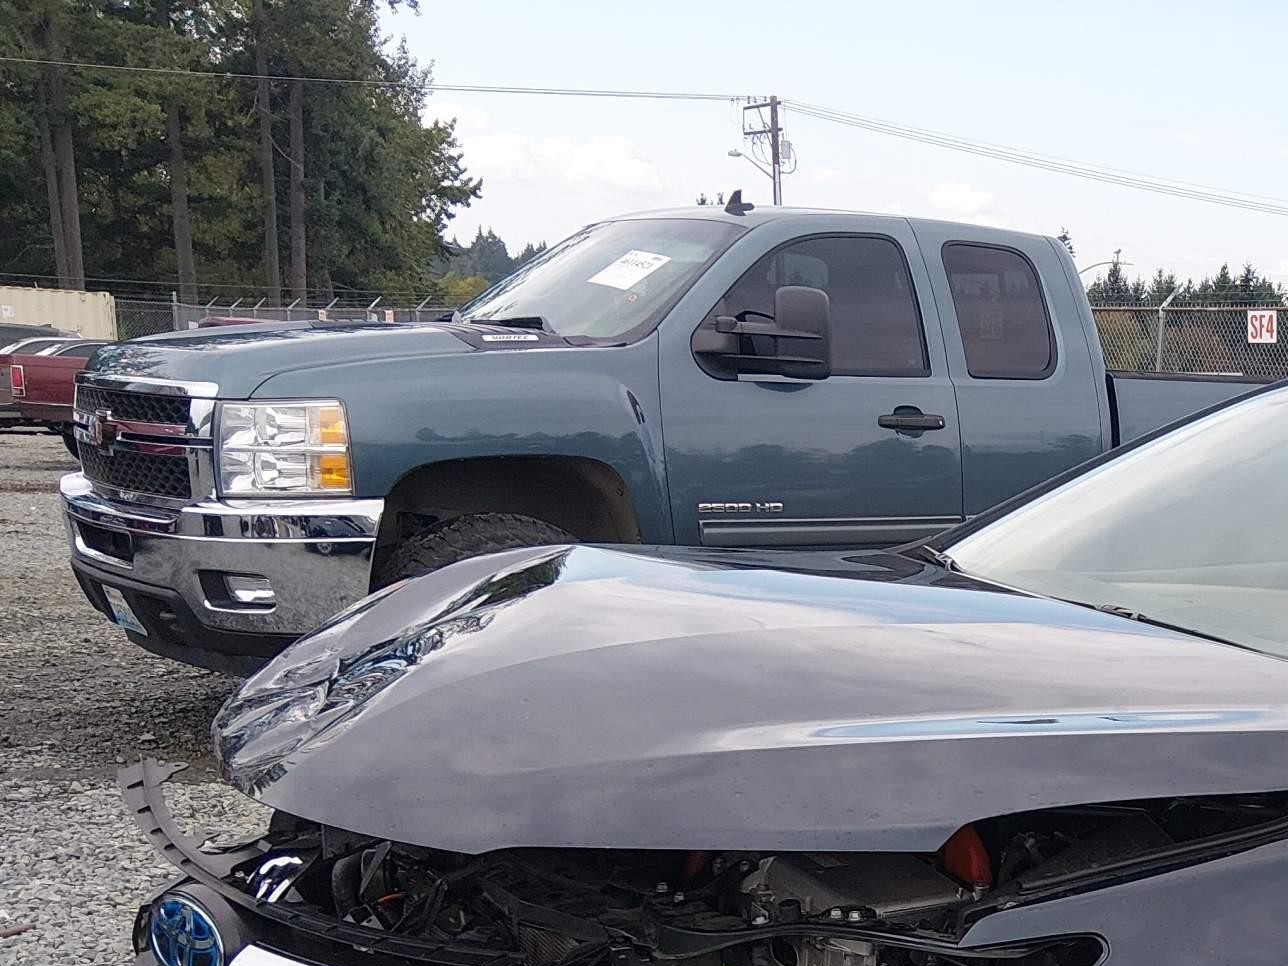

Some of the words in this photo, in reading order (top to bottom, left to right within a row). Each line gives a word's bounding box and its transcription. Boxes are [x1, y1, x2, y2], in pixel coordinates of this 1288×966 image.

[1250, 314, 1274, 339] SF4
[698, 503, 751, 513] 2500
[755, 502, 784, 513] HD
